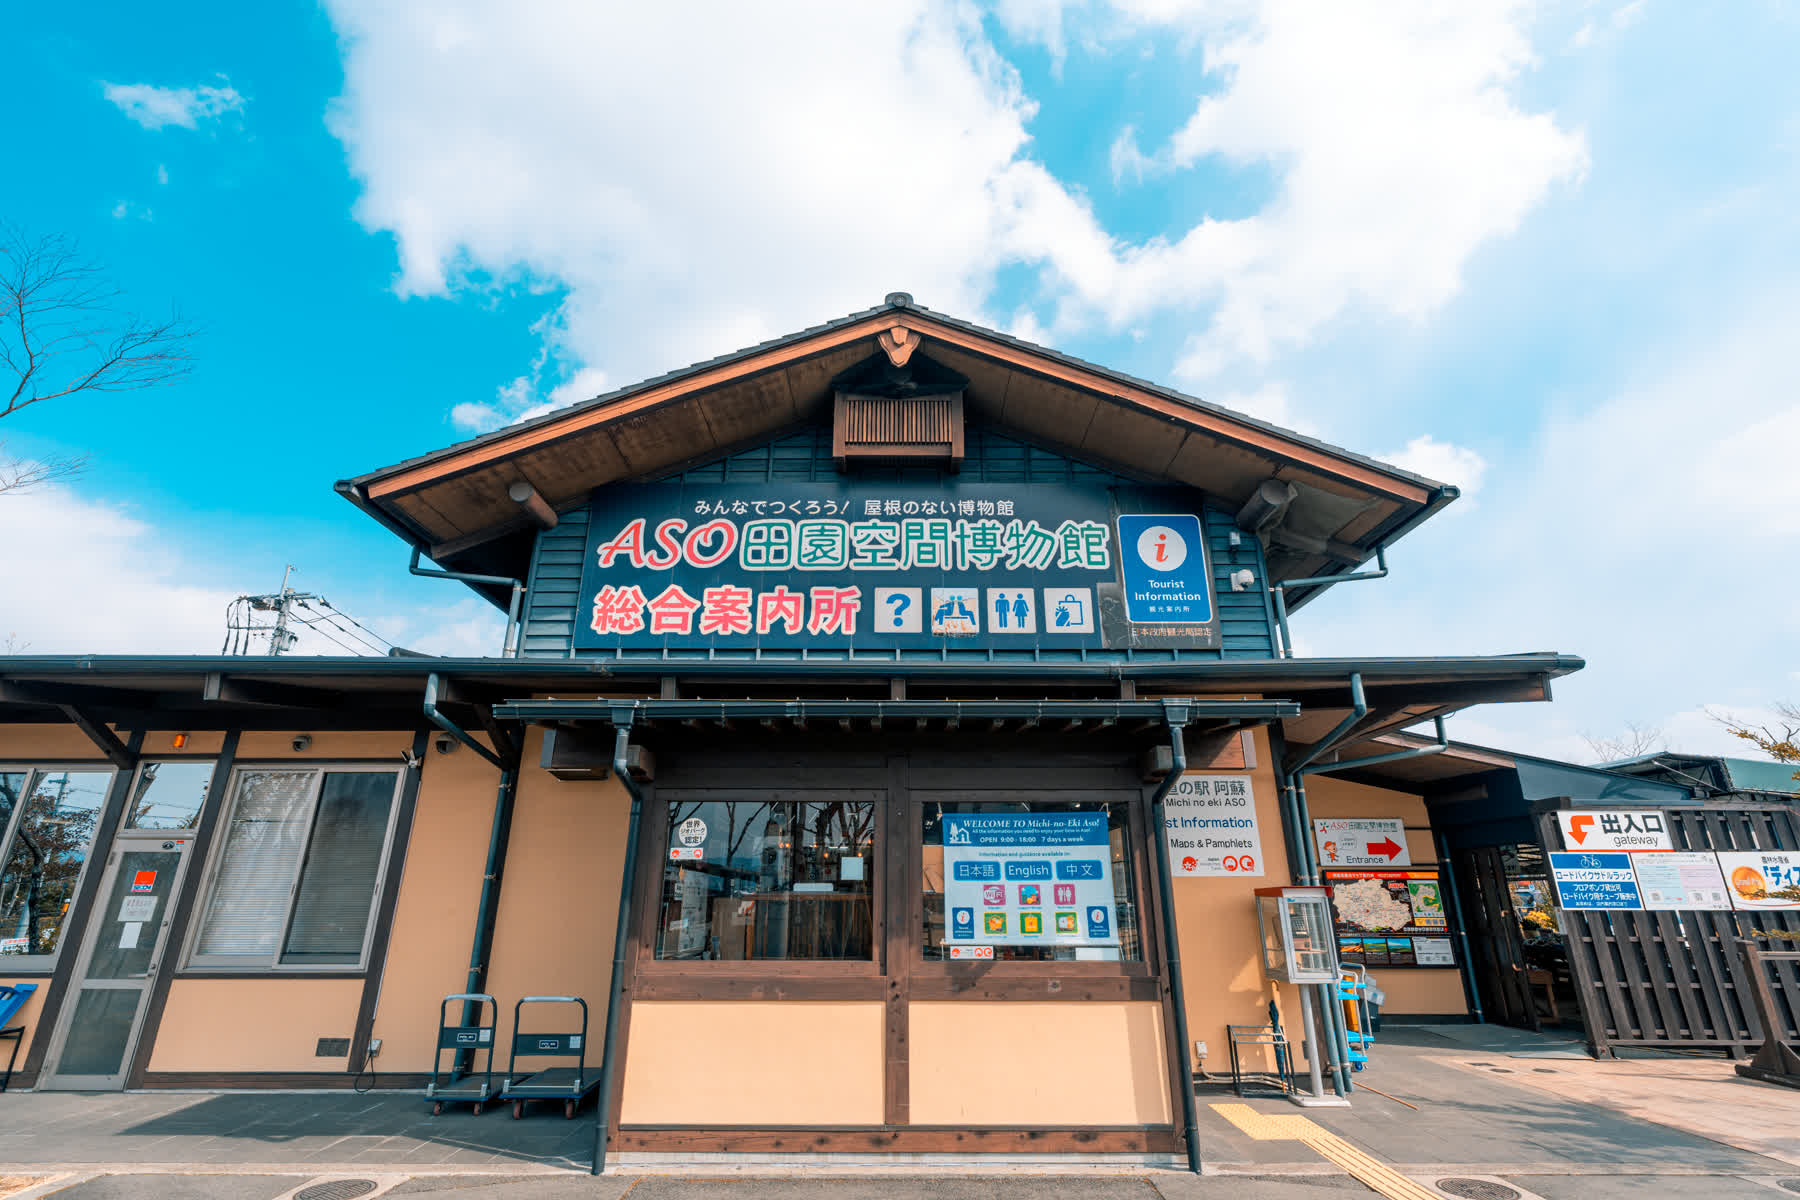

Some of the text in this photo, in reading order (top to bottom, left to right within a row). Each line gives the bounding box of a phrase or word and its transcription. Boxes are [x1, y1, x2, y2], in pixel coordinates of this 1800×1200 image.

[864, 500, 1014, 515] 屋根のない博物館
[1148, 580, 1184, 589] Tourist
[1135, 592, 1201, 601] Information
[590, 584, 861, 635] 総合案内所
[1214, 781, 1245, 796] 阿蘇
[1166, 798, 1246, 807] Michi no eki ASO
[963, 819, 1011, 828] WELCOME
[1013, 820, 1026, 828] TO
[1083, 818, 1100, 827] Aso!
[1181, 817, 1253, 829] Information
[1599, 814, 1664, 834] 出入口
[1047, 836, 1061, 844] days
[1170, 838, 1253, 849] Maps & Pamphlets
[1613, 835, 1658, 847] gateway
[1346, 855, 1383, 864] Entrance
[960, 864, 994, 877] 日本語
[1008, 865, 1049, 878] English
[1066, 864, 1094, 877] 中文
[1555, 871, 1632, 880] ロードバイクサドルラック
